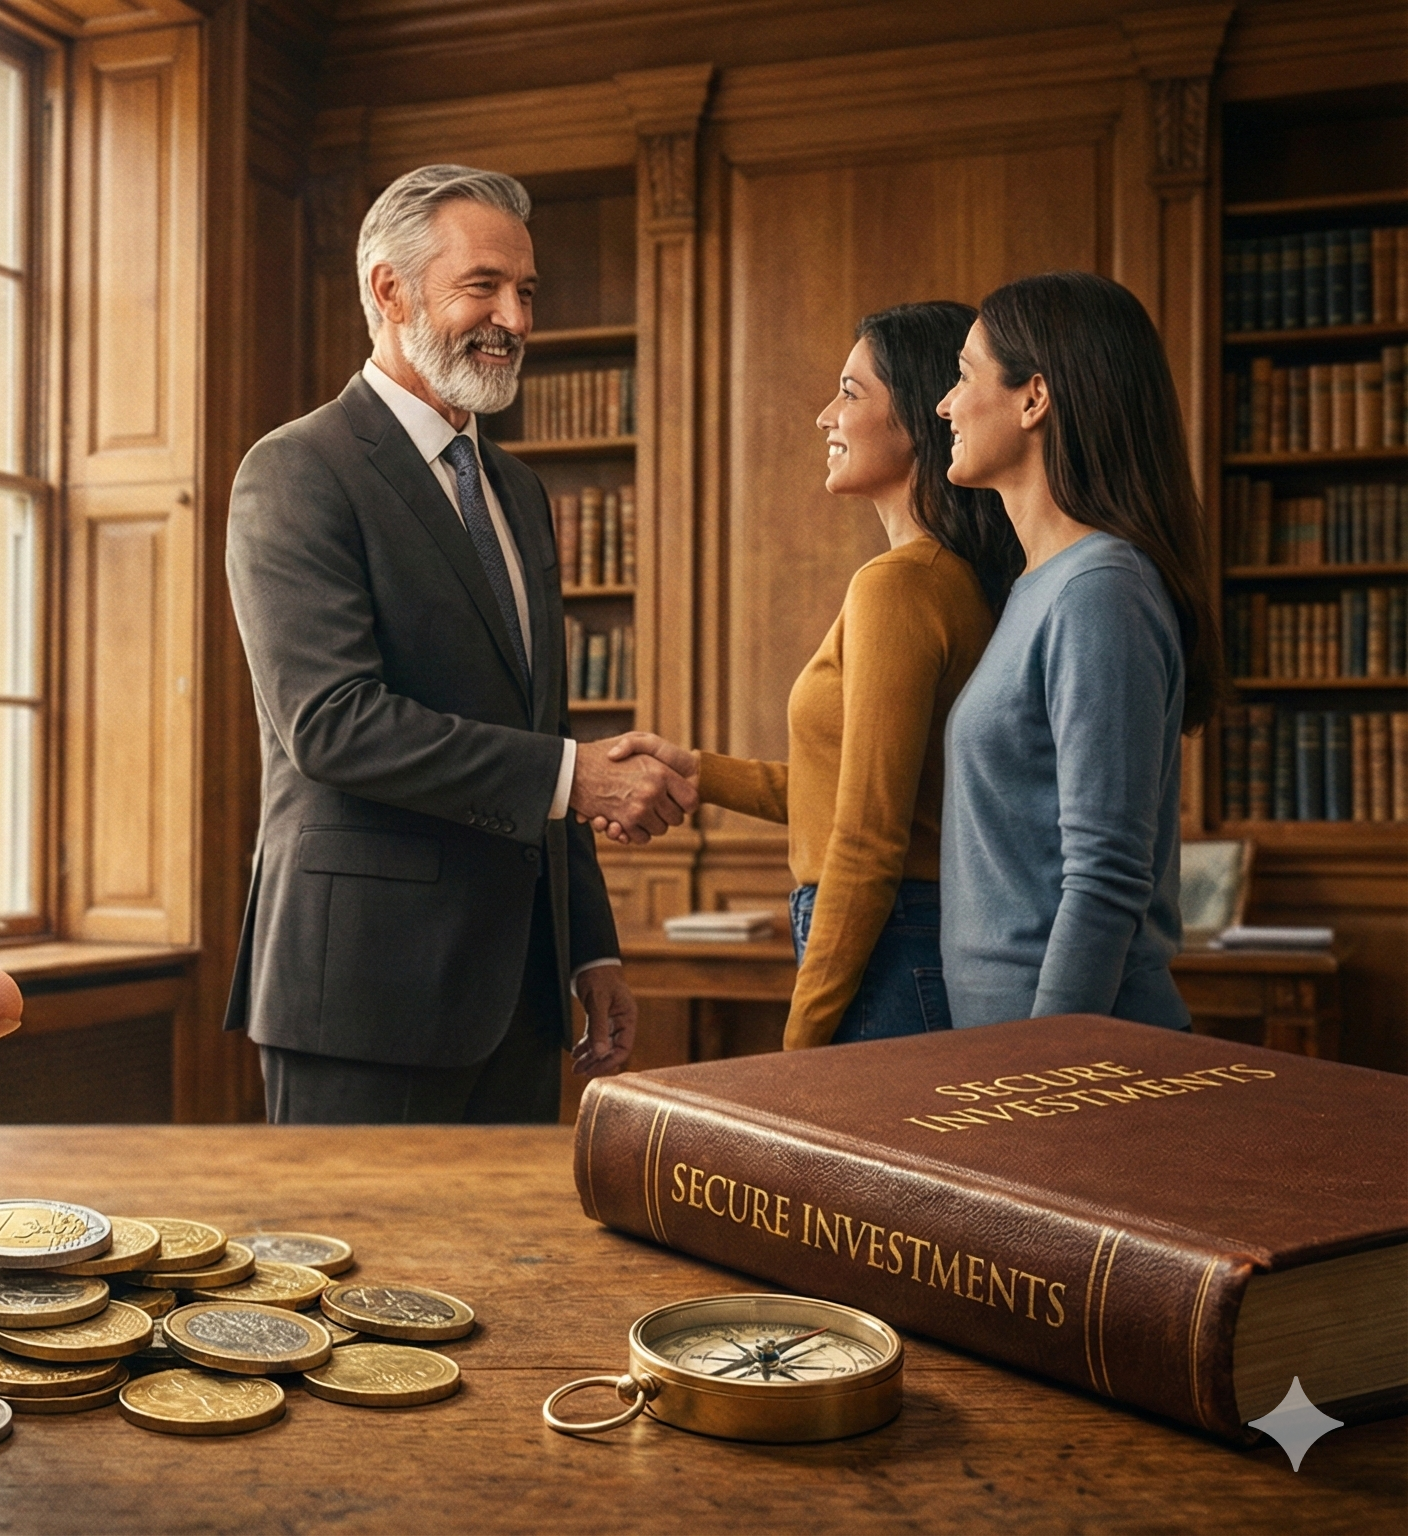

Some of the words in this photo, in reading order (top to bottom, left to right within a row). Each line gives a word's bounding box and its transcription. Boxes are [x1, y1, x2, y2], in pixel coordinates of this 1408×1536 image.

[903, 1063, 1276, 1133] INVESTMENTS
[935, 1060, 1143, 1102] SECURE
[671, 1162, 790, 1239] SECURE
[800, 1202, 1067, 1328] INVESTMENTS
